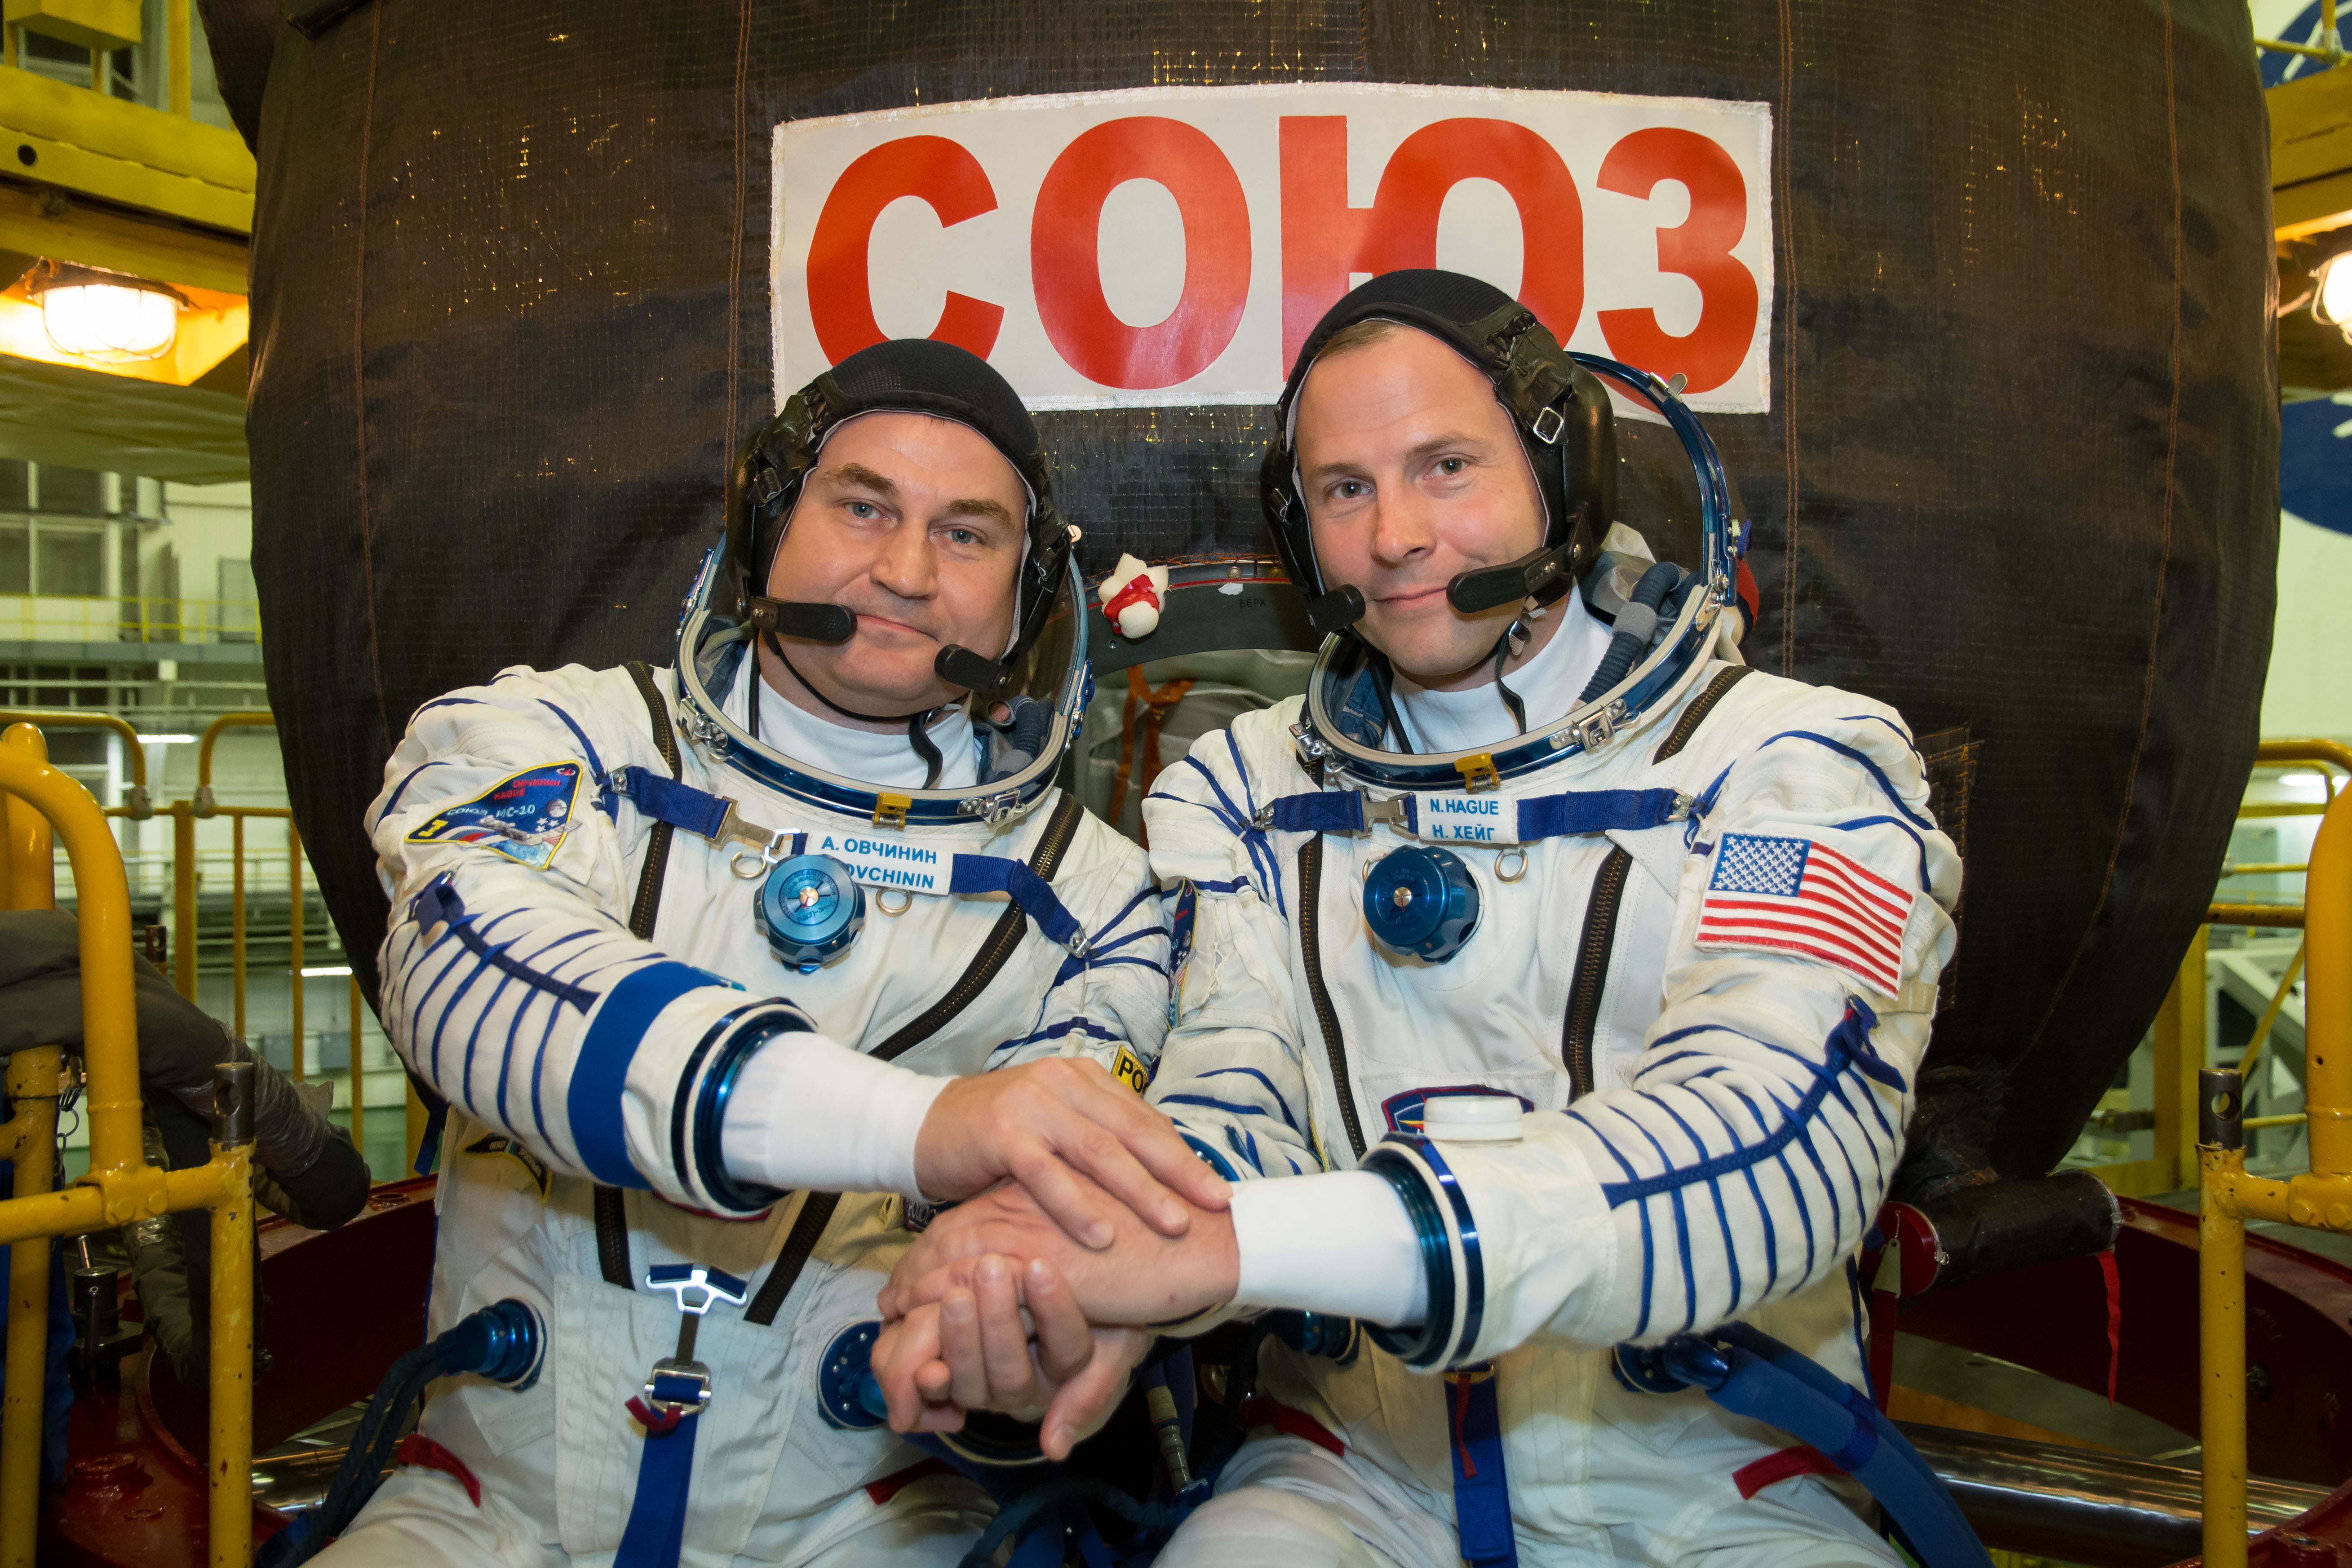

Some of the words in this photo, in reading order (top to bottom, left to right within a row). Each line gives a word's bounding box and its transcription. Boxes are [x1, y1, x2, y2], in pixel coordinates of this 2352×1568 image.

[807, 115, 1759, 395] СОЮЗ
[1239, 598, 1266, 608] ВЕРХ
[512, 779, 561, 788] ОВЧИНИН
[494, 788, 525, 800] HAGUE
[496, 805, 536, 818] МС-10
[1432, 824, 1448, 838] Н.
[1453, 823, 1495, 841] ХЕЙГ
[821, 836, 839, 851] А.
[844, 838, 937, 864] ОВЧИНИН
